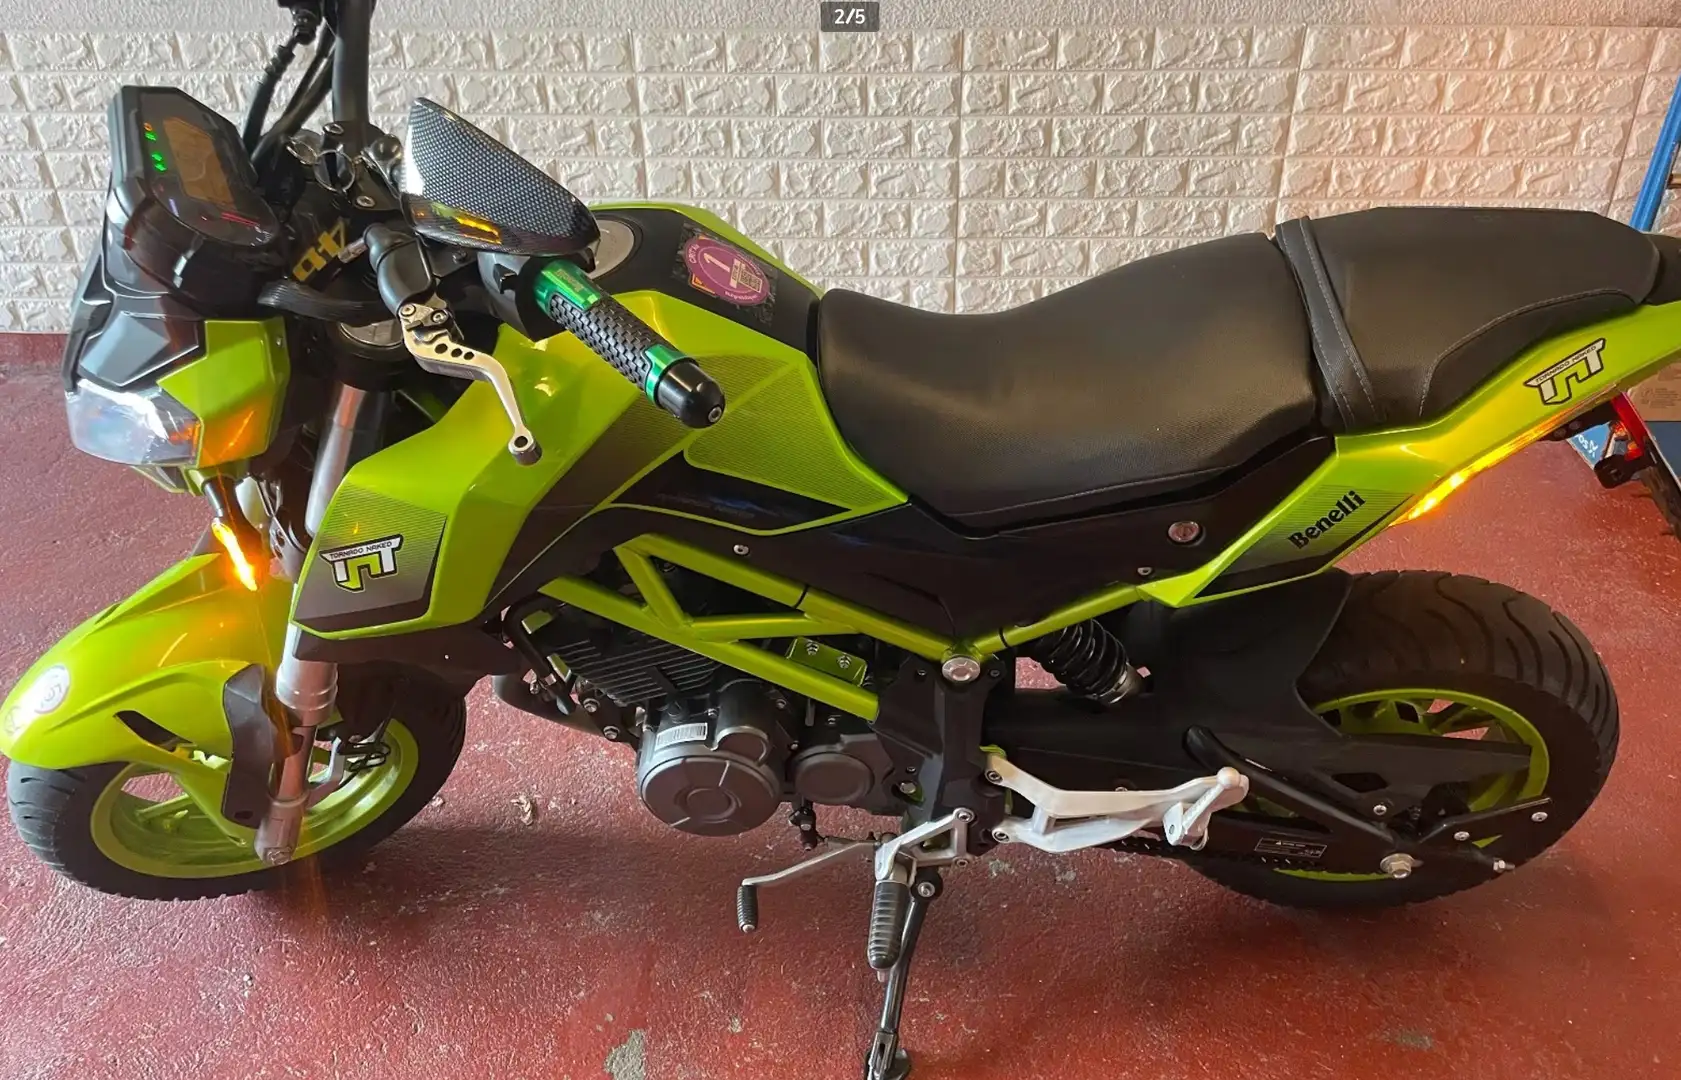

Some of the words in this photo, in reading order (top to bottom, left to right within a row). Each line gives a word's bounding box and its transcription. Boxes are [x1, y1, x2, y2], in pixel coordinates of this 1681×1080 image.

[1534, 360, 1570, 383] TORNADO
[1572, 345, 1597, 363] NAKED
[1287, 490, 1366, 550] Benelli
[329, 547, 364, 560] TORNADO
[366, 541, 393, 552] NAKED
